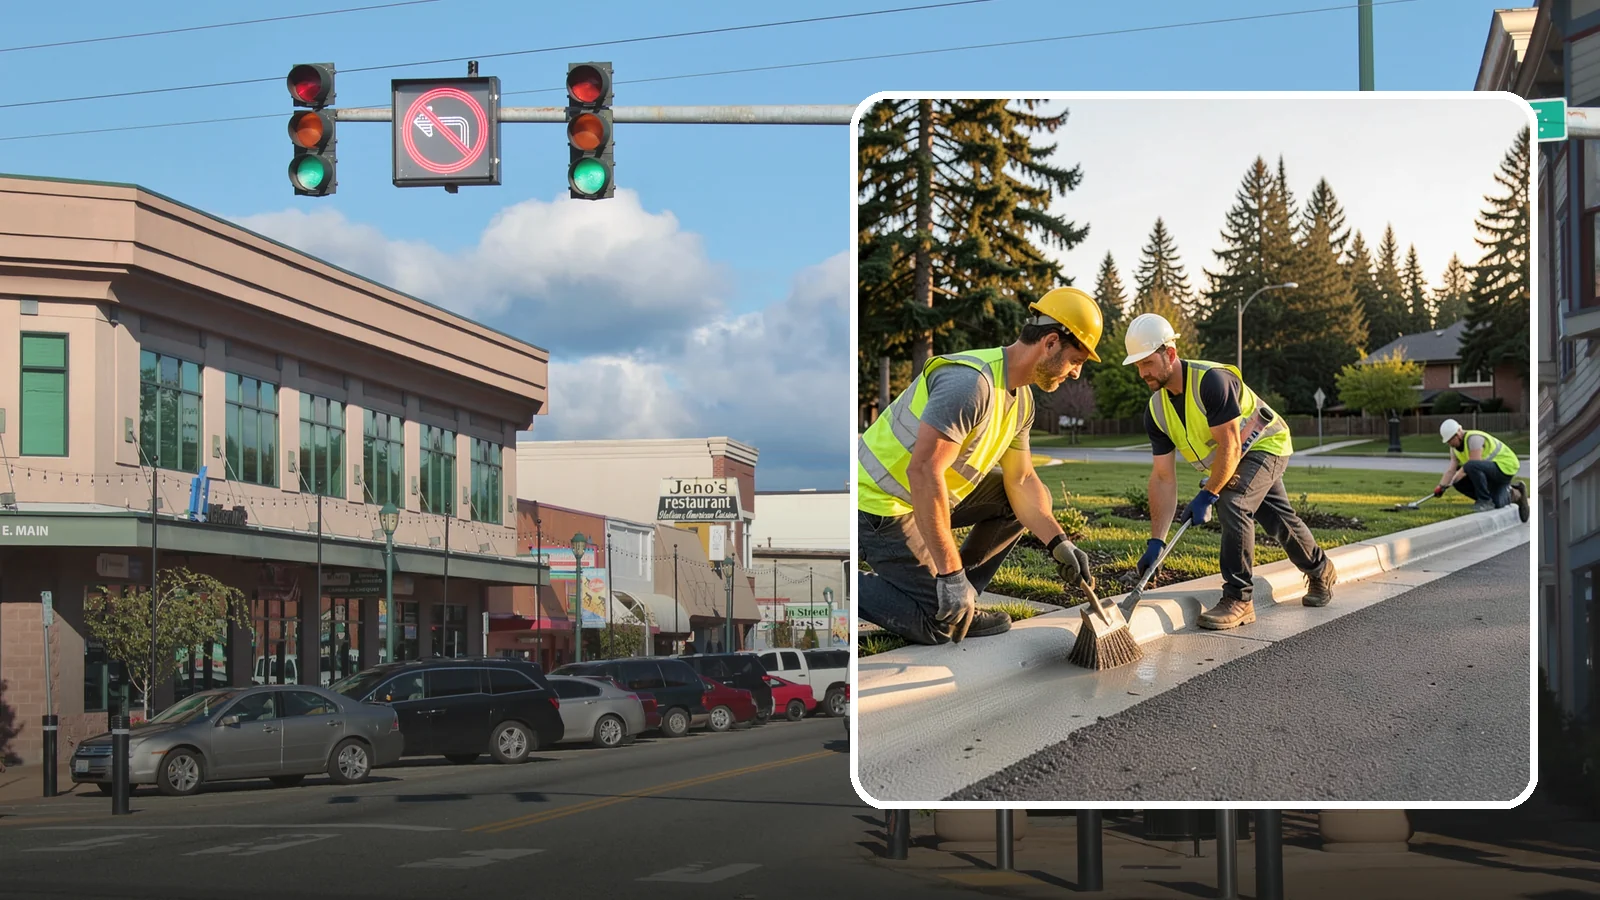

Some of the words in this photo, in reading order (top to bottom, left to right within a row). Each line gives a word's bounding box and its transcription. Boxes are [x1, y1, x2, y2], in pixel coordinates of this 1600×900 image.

[669, 480, 728, 495] Jeno's
[665, 496, 731, 509] restaurant
[658, 510, 681, 519] Italian
[685, 510, 715, 519] American
[714, 509, 738, 519] Cuisine
[2, 525, 13, 536] E.
[15, 525, 49, 536] MAIN
[797, 608, 829, 617] Street
